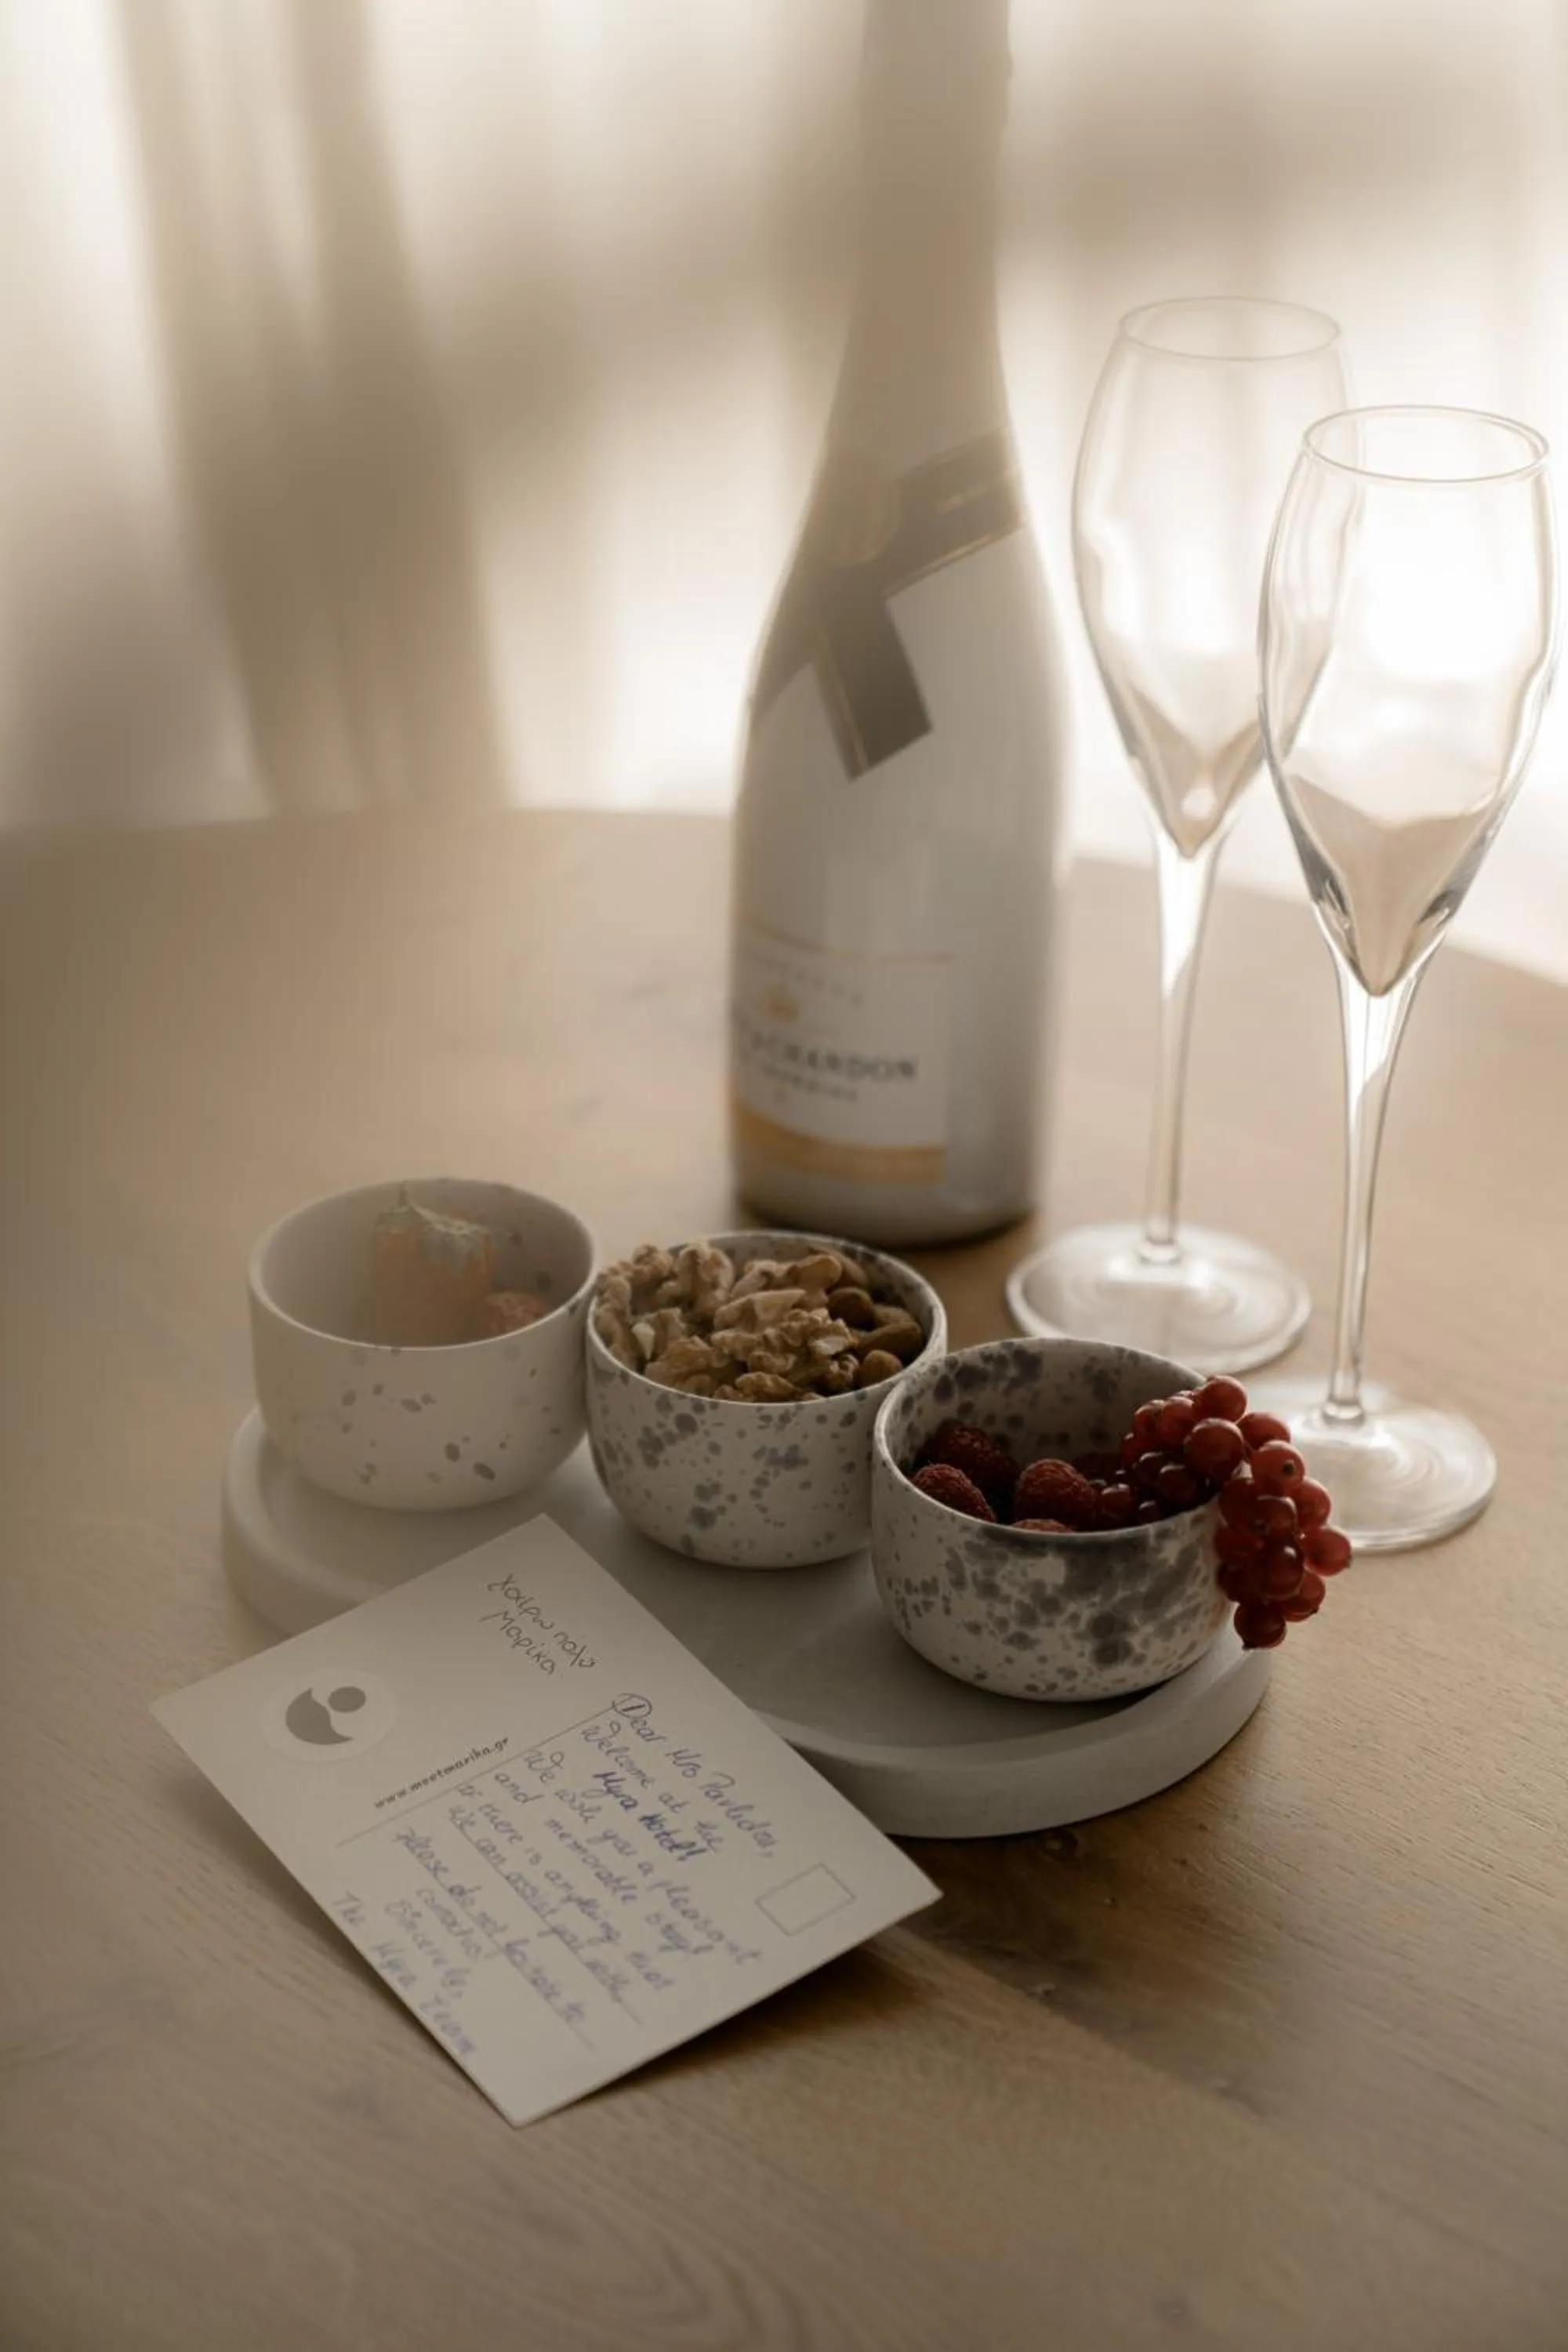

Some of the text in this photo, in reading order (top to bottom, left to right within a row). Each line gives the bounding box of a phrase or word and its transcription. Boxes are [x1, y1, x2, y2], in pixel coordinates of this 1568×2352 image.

[580, 1719, 654, 1788] Welcome
[656, 1791, 690, 1815] at
[611, 1693, 665, 1742] Dear
[664, 1748, 702, 1779] Mrs
[493, 1772, 545, 1805] and
[546, 1818, 638, 1903] memorable
[582, 1770, 638, 1811] Myra
[523, 1741, 565, 1784] We
[585, 1828, 635, 1857] you
[636, 1860, 654, 1878] a
[645, 1880, 764, 1965] pleasant
